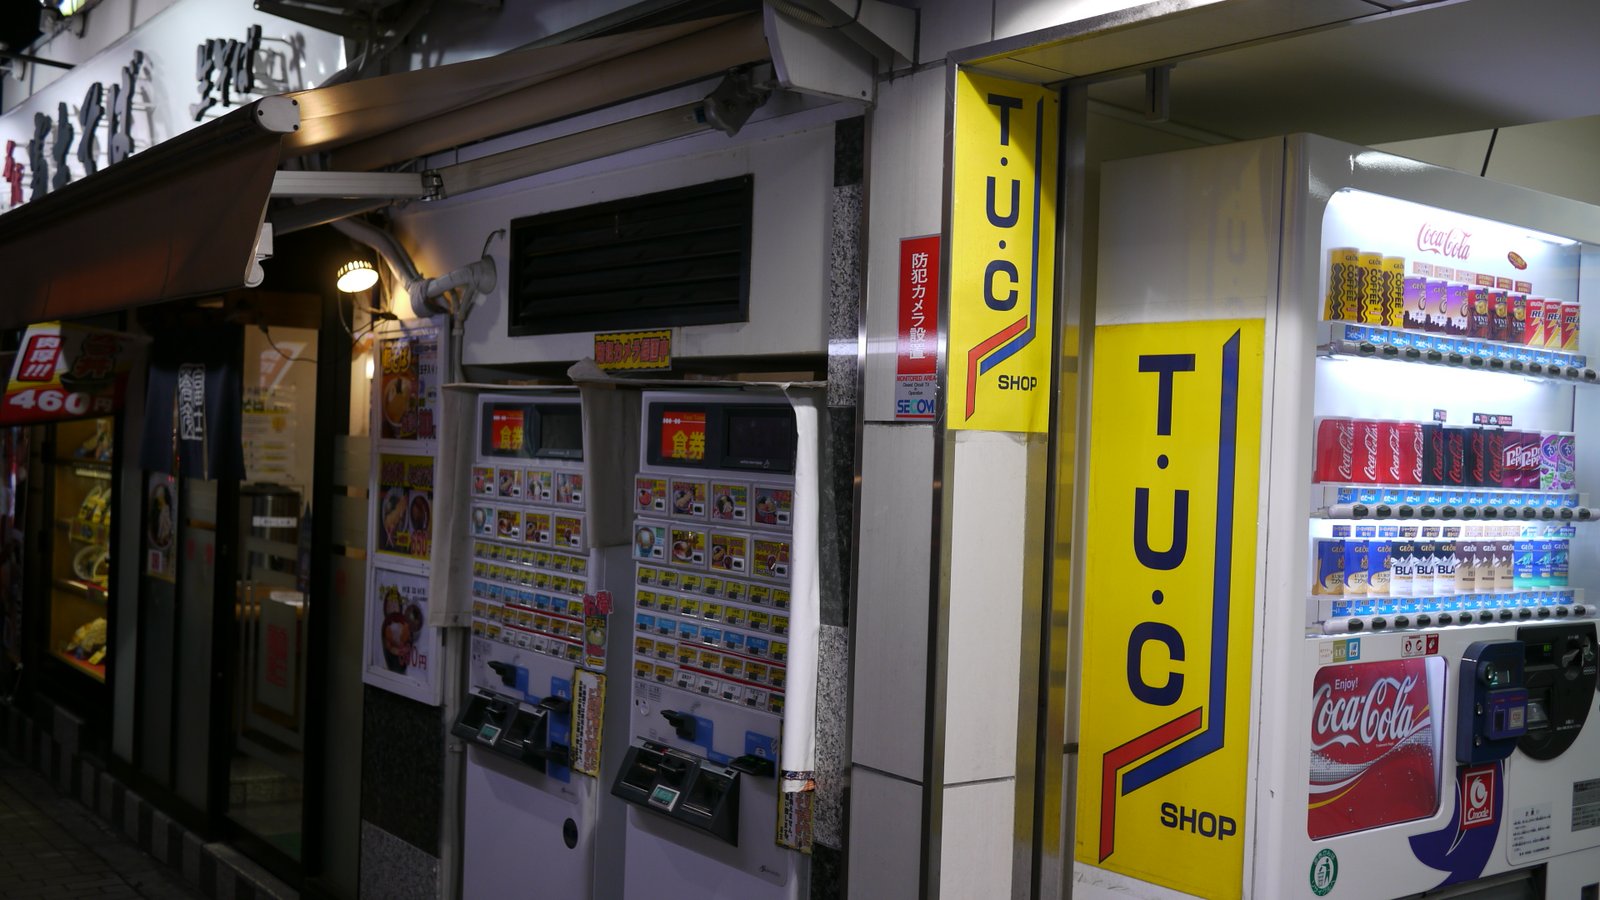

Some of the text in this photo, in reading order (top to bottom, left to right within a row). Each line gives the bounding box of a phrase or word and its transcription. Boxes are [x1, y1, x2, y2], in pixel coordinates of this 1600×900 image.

[1346, 264, 1355, 302] COFFEE
[1369, 268, 1378, 305] COFFEE
[1394, 272, 1403, 309] COFFEE
[909, 252, 929, 360] 防犯カメラ設置
[997, 374, 1038, 392] SHOP
[897, 399, 935, 414] SECOM
[499, 425, 524, 450] 食券
[671, 430, 706, 460] 食券
[1506, 449, 1522, 467] Pep
[1334, 677, 1359, 691] Enjoy!
[1160, 801, 1237, 842] SHOP
[1467, 807, 1490, 822] Cmode
